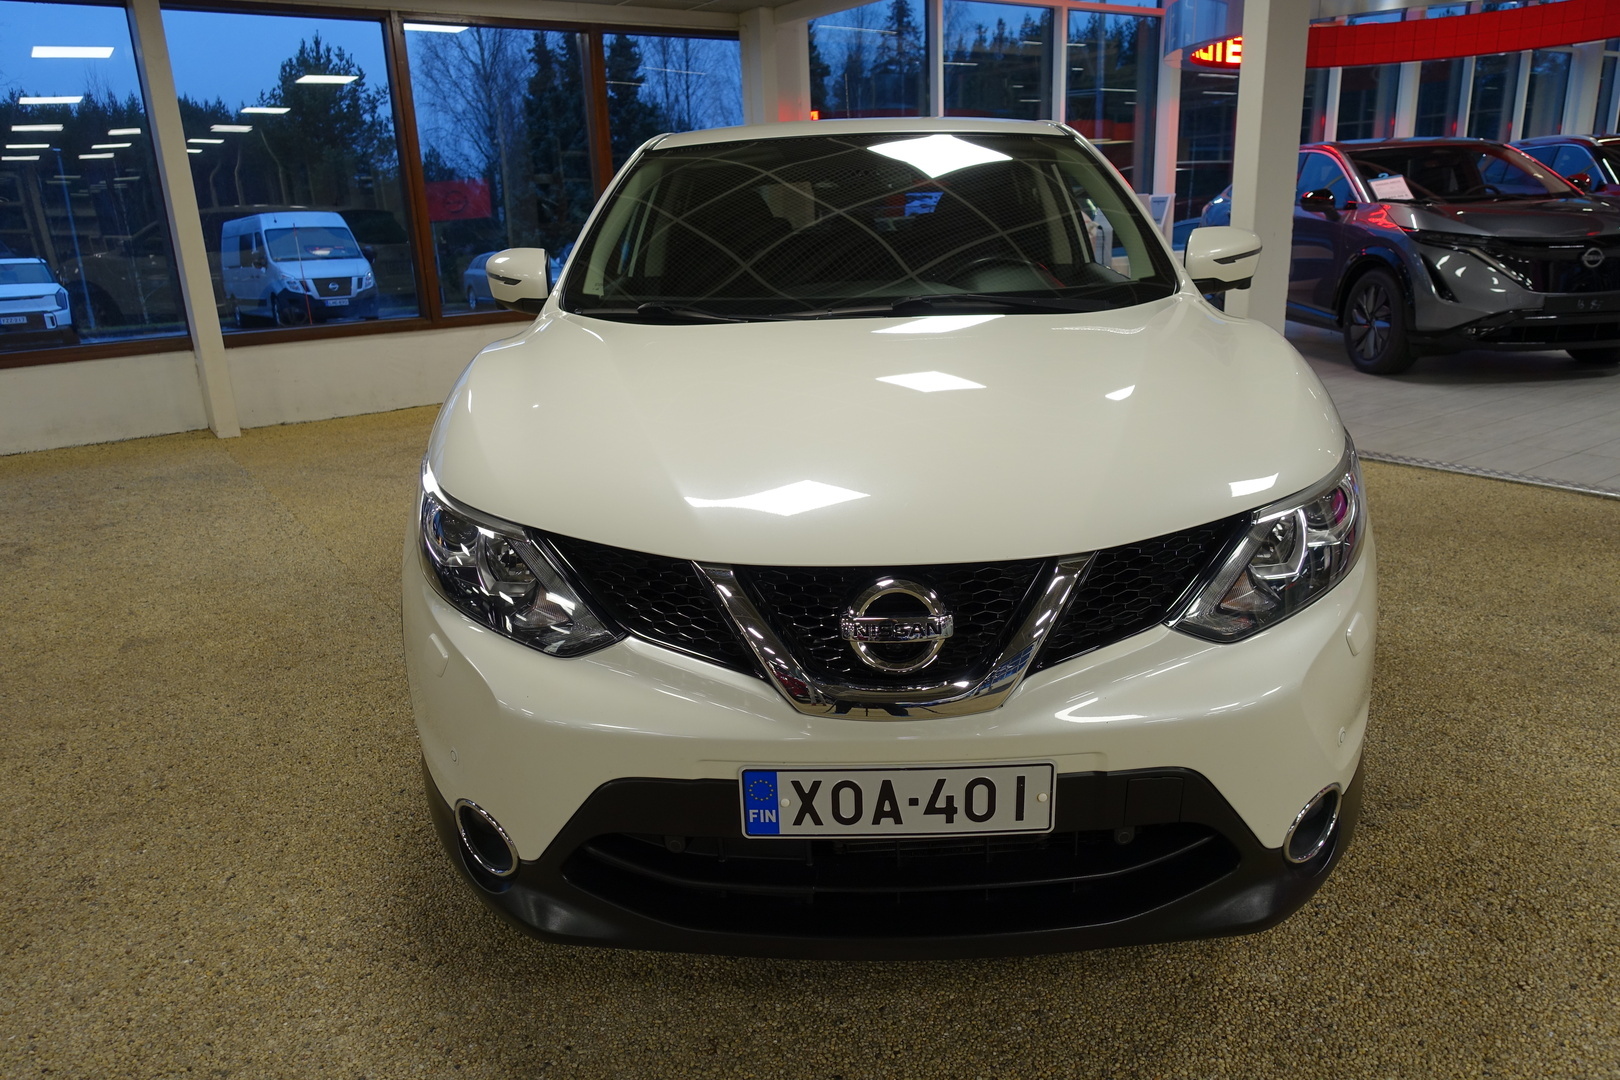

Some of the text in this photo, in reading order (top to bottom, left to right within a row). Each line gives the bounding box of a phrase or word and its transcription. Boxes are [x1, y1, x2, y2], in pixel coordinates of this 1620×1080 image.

[853, 622, 942, 638] NISSAN
[790, 775, 1026, 826] XOA-401
[749, 809, 777, 823] FIN
